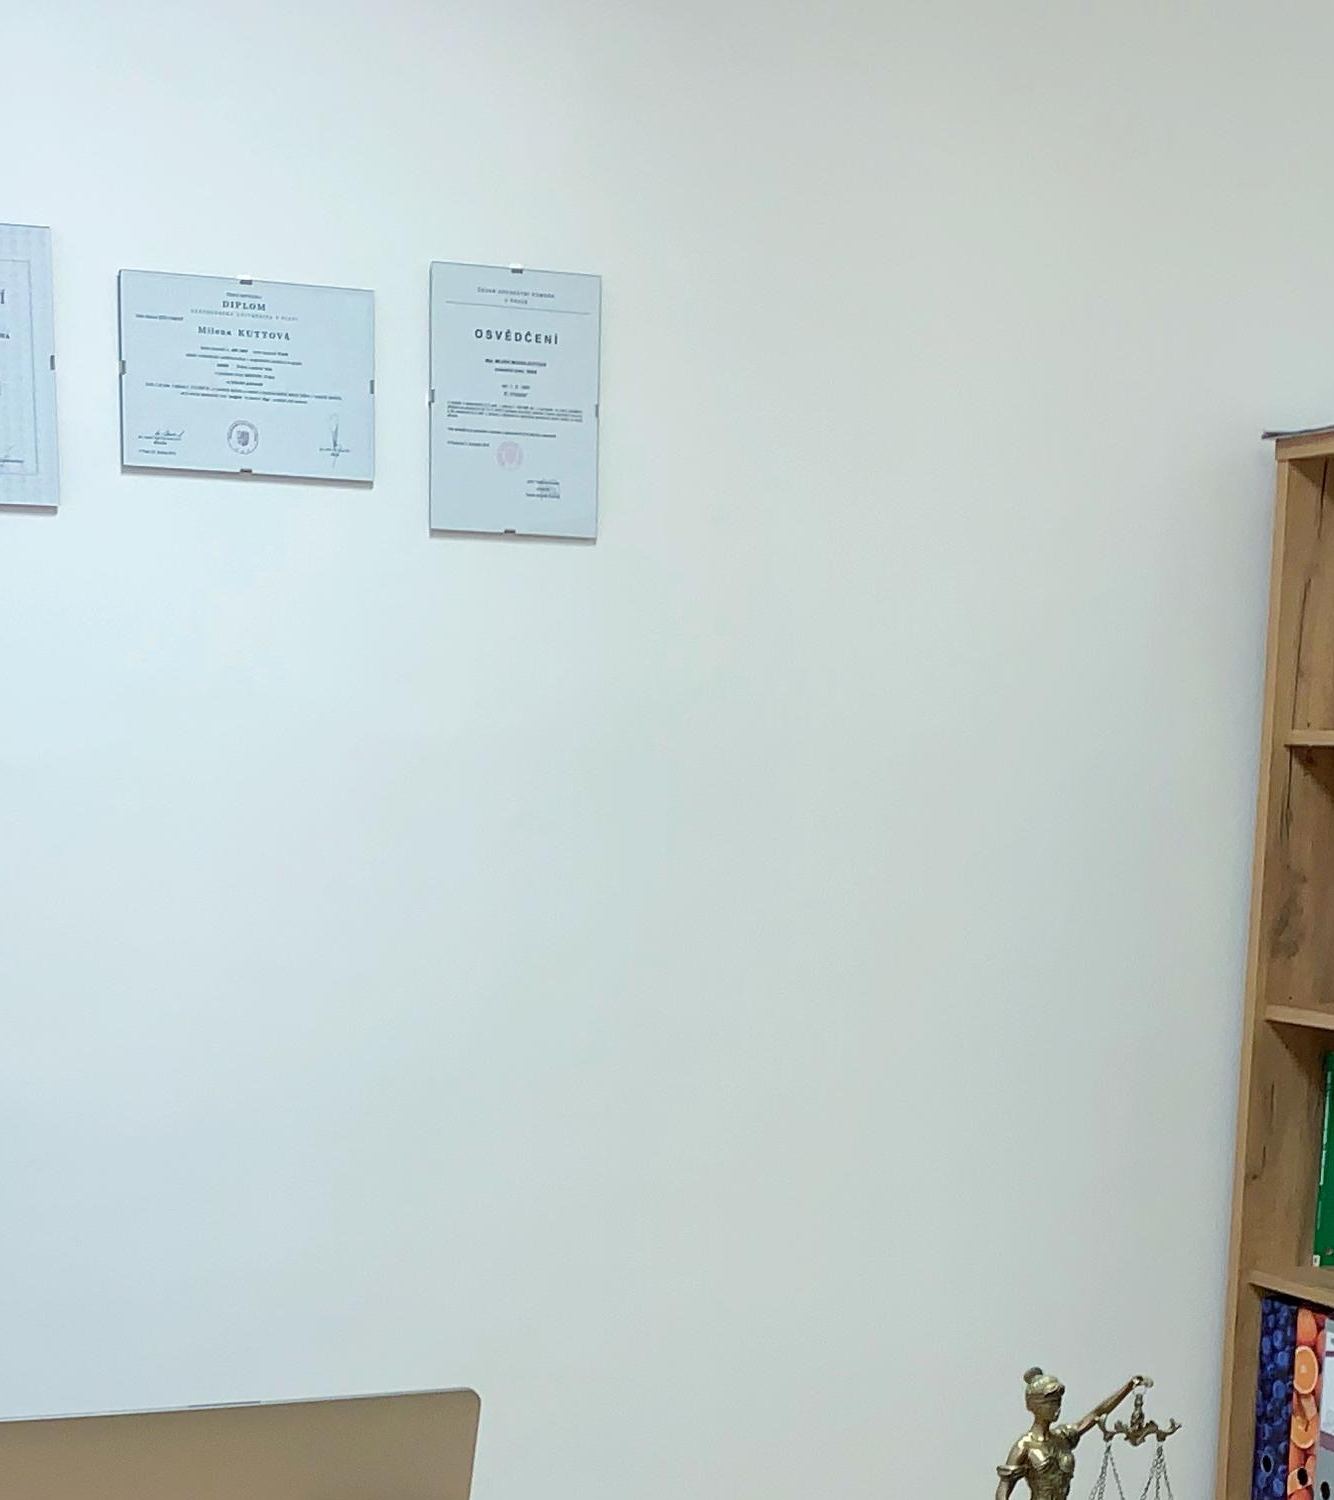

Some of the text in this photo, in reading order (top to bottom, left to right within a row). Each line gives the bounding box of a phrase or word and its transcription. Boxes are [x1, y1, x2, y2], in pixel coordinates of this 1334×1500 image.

[222, 300, 266, 312] DIPLOM
[197, 325, 232, 336] Milena
[474, 329, 559, 345] OSVĚDČENÍ
